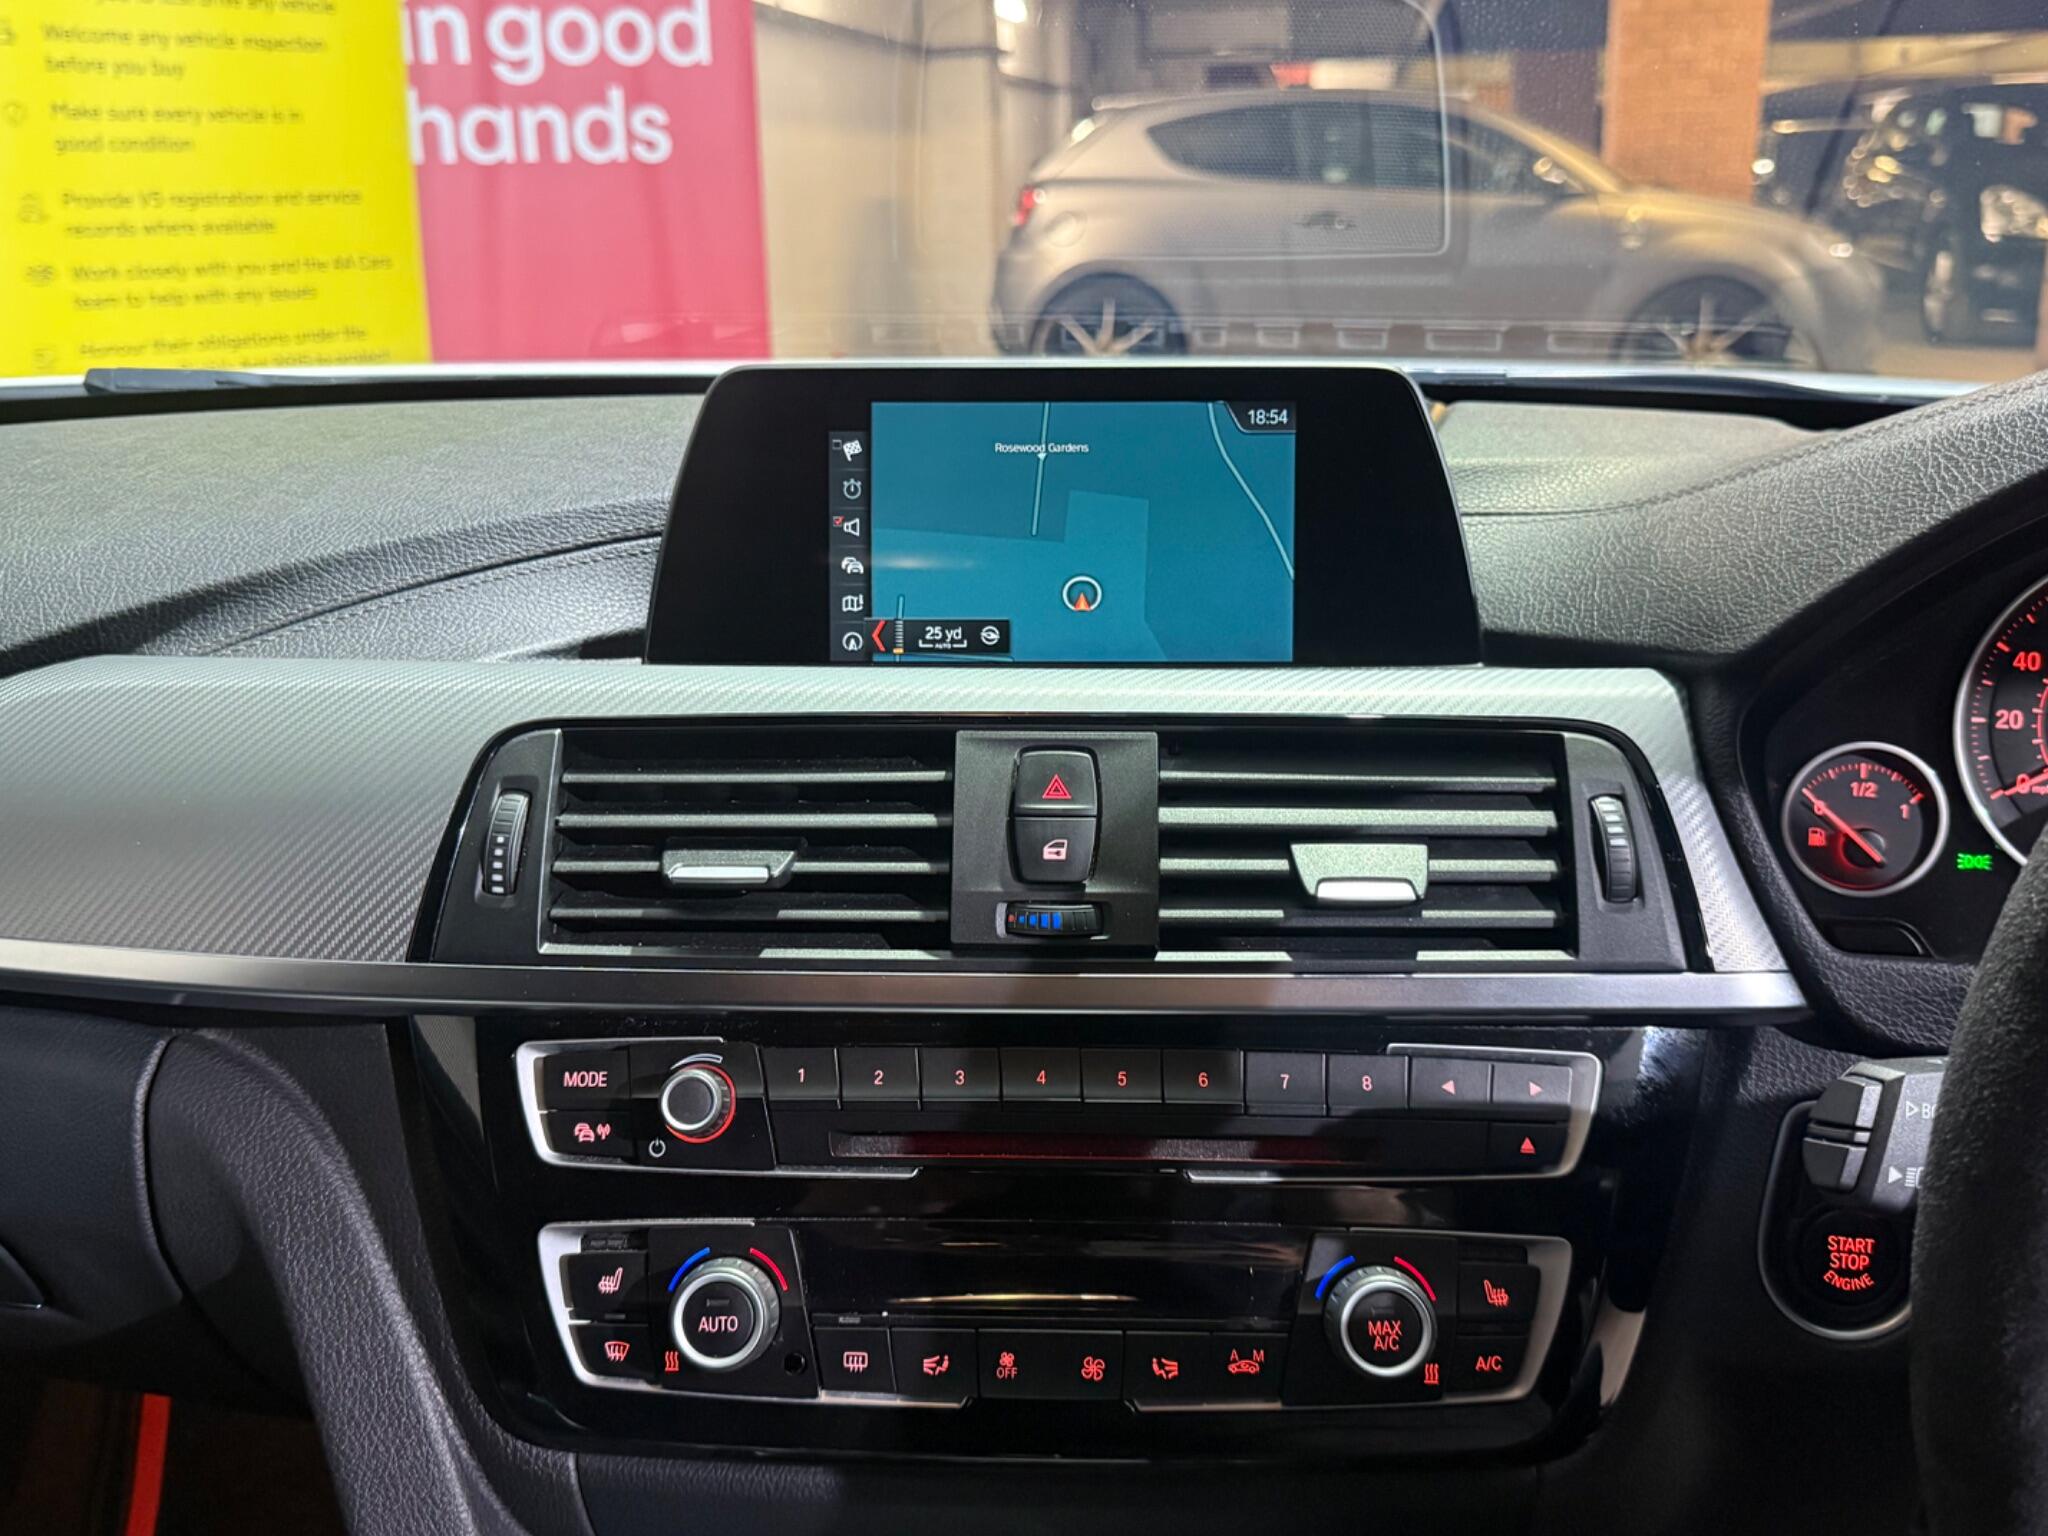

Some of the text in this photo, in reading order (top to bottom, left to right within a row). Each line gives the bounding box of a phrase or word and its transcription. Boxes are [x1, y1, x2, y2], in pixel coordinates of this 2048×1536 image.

[43, 24, 132, 46] Welcome
[138, 32, 170, 50] any
[175, 31, 236, 49] vehicle
[485, 0, 713, 86] good
[44, 56, 185, 80] before you buy
[50, 103, 99, 120] Make
[152, 107, 201, 125] every
[207, 107, 265, 123] vehicle
[408, 83, 673, 166] hands
[54, 134, 194, 155] good condition
[169, 191, 265, 211] registration
[271, 191, 302, 206] and
[307, 192, 363, 206] service
[144, 221, 196, 236] where
[202, 219, 276, 235] available
[194, 261, 229, 279] with
[236, 263, 265, 280] you
[269, 259, 300, 275] and
[197, 331, 290, 351] obligations
[1247, 408, 1288, 425] 18:54
[994, 442, 1089, 453] Rosewood Gardens
[925, 626, 962, 642] 25 yd
[2012, 651, 2041, 671] 40
[1995, 709, 2024, 730] 20
[1850, 781, 1878, 798] 1/2
[1900, 804, 1910, 819] 1
[564, 1071, 608, 1088] MODE
[797, 1068, 805, 1083] 1
[874, 1070, 884, 1086] 2
[954, 1070, 965, 1086] 3
[1036, 1070, 1047, 1085] 4
[1117, 1071, 1128, 1087] 5
[1198, 1071, 1208, 1087] 6
[1280, 1074, 1290, 1090] 7
[1361, 1075, 1373, 1091] 8
[1827, 1235, 1875, 1254] START
[1829, 1252, 1870, 1271] STOP
[1823, 1269, 1875, 1291] ENGINE
[698, 1316, 738, 1333] AUTO
[1368, 1320, 1402, 1337] MAX
[1373, 1336, 1400, 1351] A/C
[1229, 1349, 1265, 1363] A M
[1475, 1356, 1503, 1372] A/C
[996, 1367, 1018, 1380] OFF
